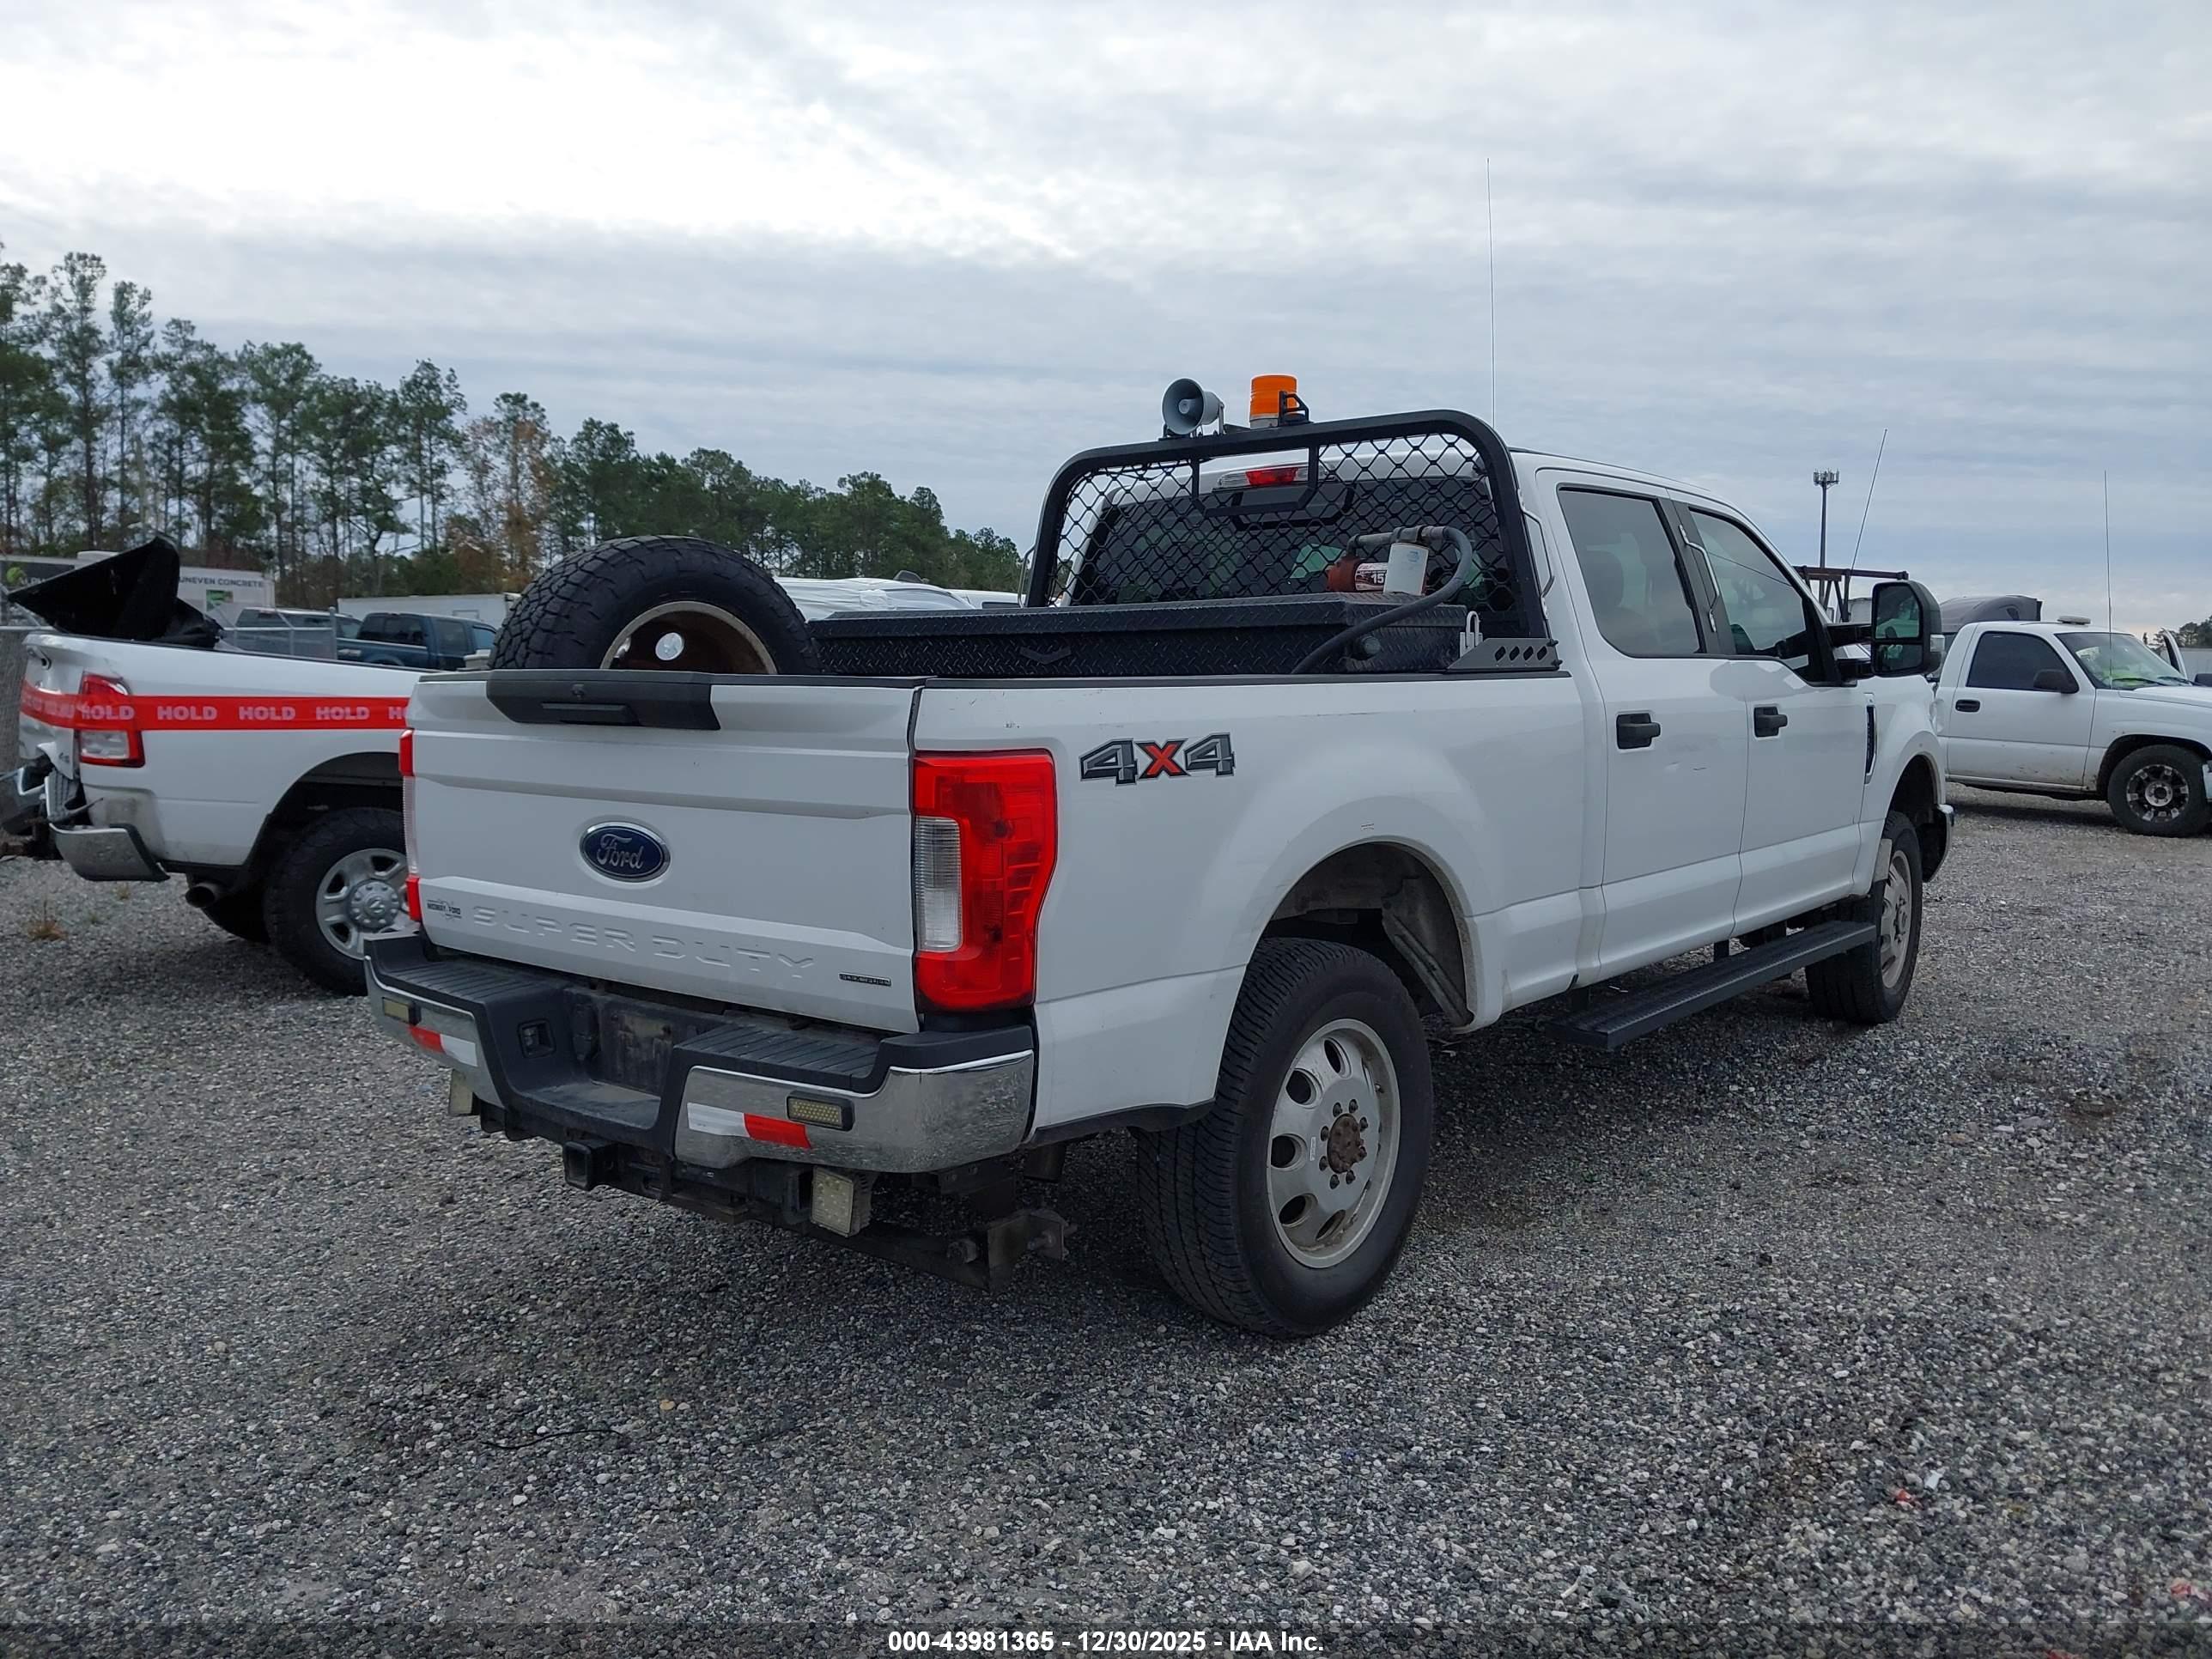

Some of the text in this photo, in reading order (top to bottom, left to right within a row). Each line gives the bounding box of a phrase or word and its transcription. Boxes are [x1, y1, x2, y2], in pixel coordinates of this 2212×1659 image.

[218, 578, 262, 587] CONCRETE
[157, 705, 217, 721] HOLD
[239, 706, 296, 720] HOLD
[315, 705, 370, 720] HOLD
[597, 833, 645, 869] Ford
[473, 905, 815, 979] SUPER DUTY
